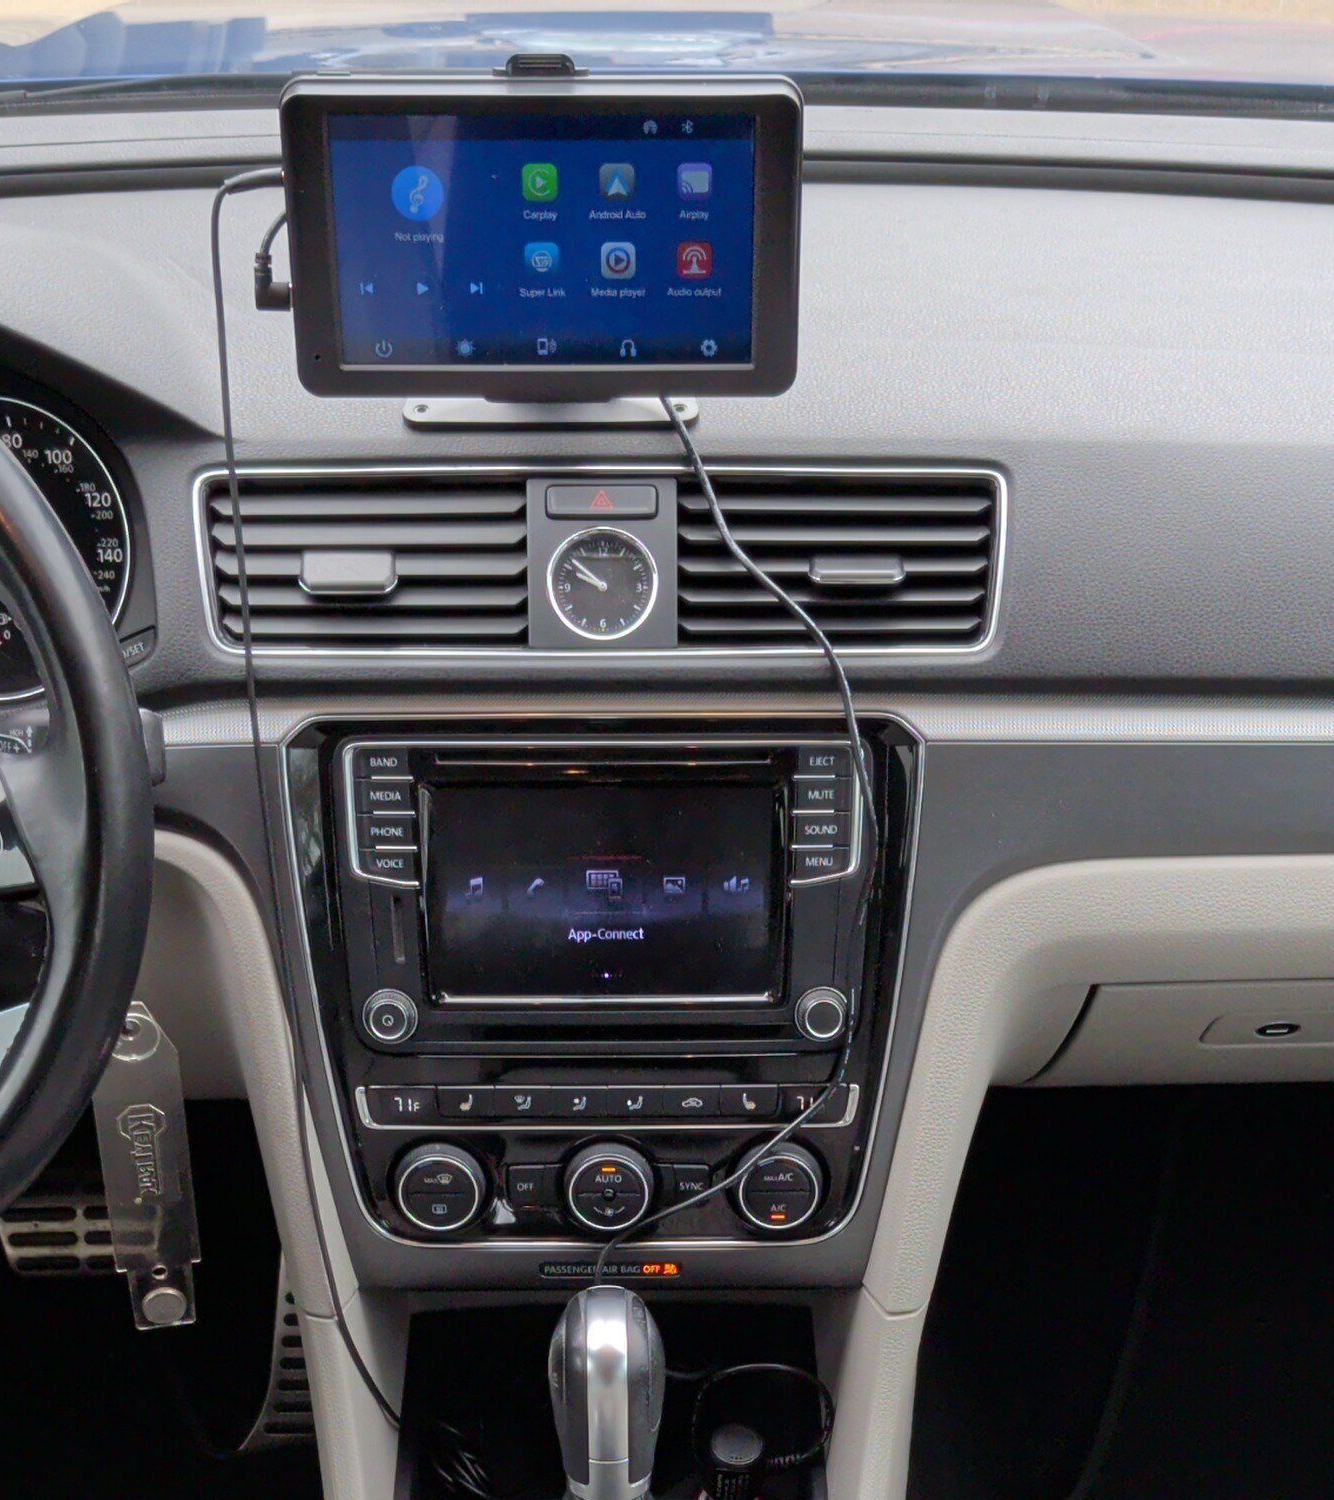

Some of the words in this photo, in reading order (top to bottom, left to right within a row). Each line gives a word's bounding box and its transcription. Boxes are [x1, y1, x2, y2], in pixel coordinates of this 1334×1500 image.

[523, 210, 558, 222] Carplay
[588, 210, 623, 219] Android
[625, 210, 647, 219] Auto
[679, 210, 709, 221] Airplay
[395, 232, 411, 242] Not
[412, 232, 444, 243] playing
[519, 287, 545, 298] Super
[546, 287, 566, 297] Link
[591, 288, 617, 297] Media
[619, 287, 646, 299] player
[667, 287, 692, 297] Audio
[694, 287, 722, 299] output
[44, 450, 72, 464] 100
[85, 492, 111, 508] 120
[97, 548, 123, 563] 140
[564, 583, 571, 593] 9
[635, 583, 643, 593] 3
[599, 618, 607, 628] 6
[3, 629, 11, 640] 0
[369, 757, 398, 767] BAND
[809, 756, 835, 767] EJECT
[369, 790, 402, 801] MEDIA
[808, 789, 835, 800] MUTE
[370, 826, 404, 837] PHONE
[804, 825, 838, 835] SOUND
[375, 858, 404, 869] VOICE
[805, 857, 834, 867] MENU
[568, 927, 644, 943] App-Connect
[595, 1174, 622, 1184] AUTO
[778, 1172, 794, 1181] A/C
[517, 1182, 534, 1191] OFF
[679, 1181, 704, 1191] SYNC
[770, 1203, 786, 1212] A/C
[601, 1265, 617, 1274] AIR
[621, 1265, 641, 1274] BAG
[642, 1265, 661, 1275] OFF
